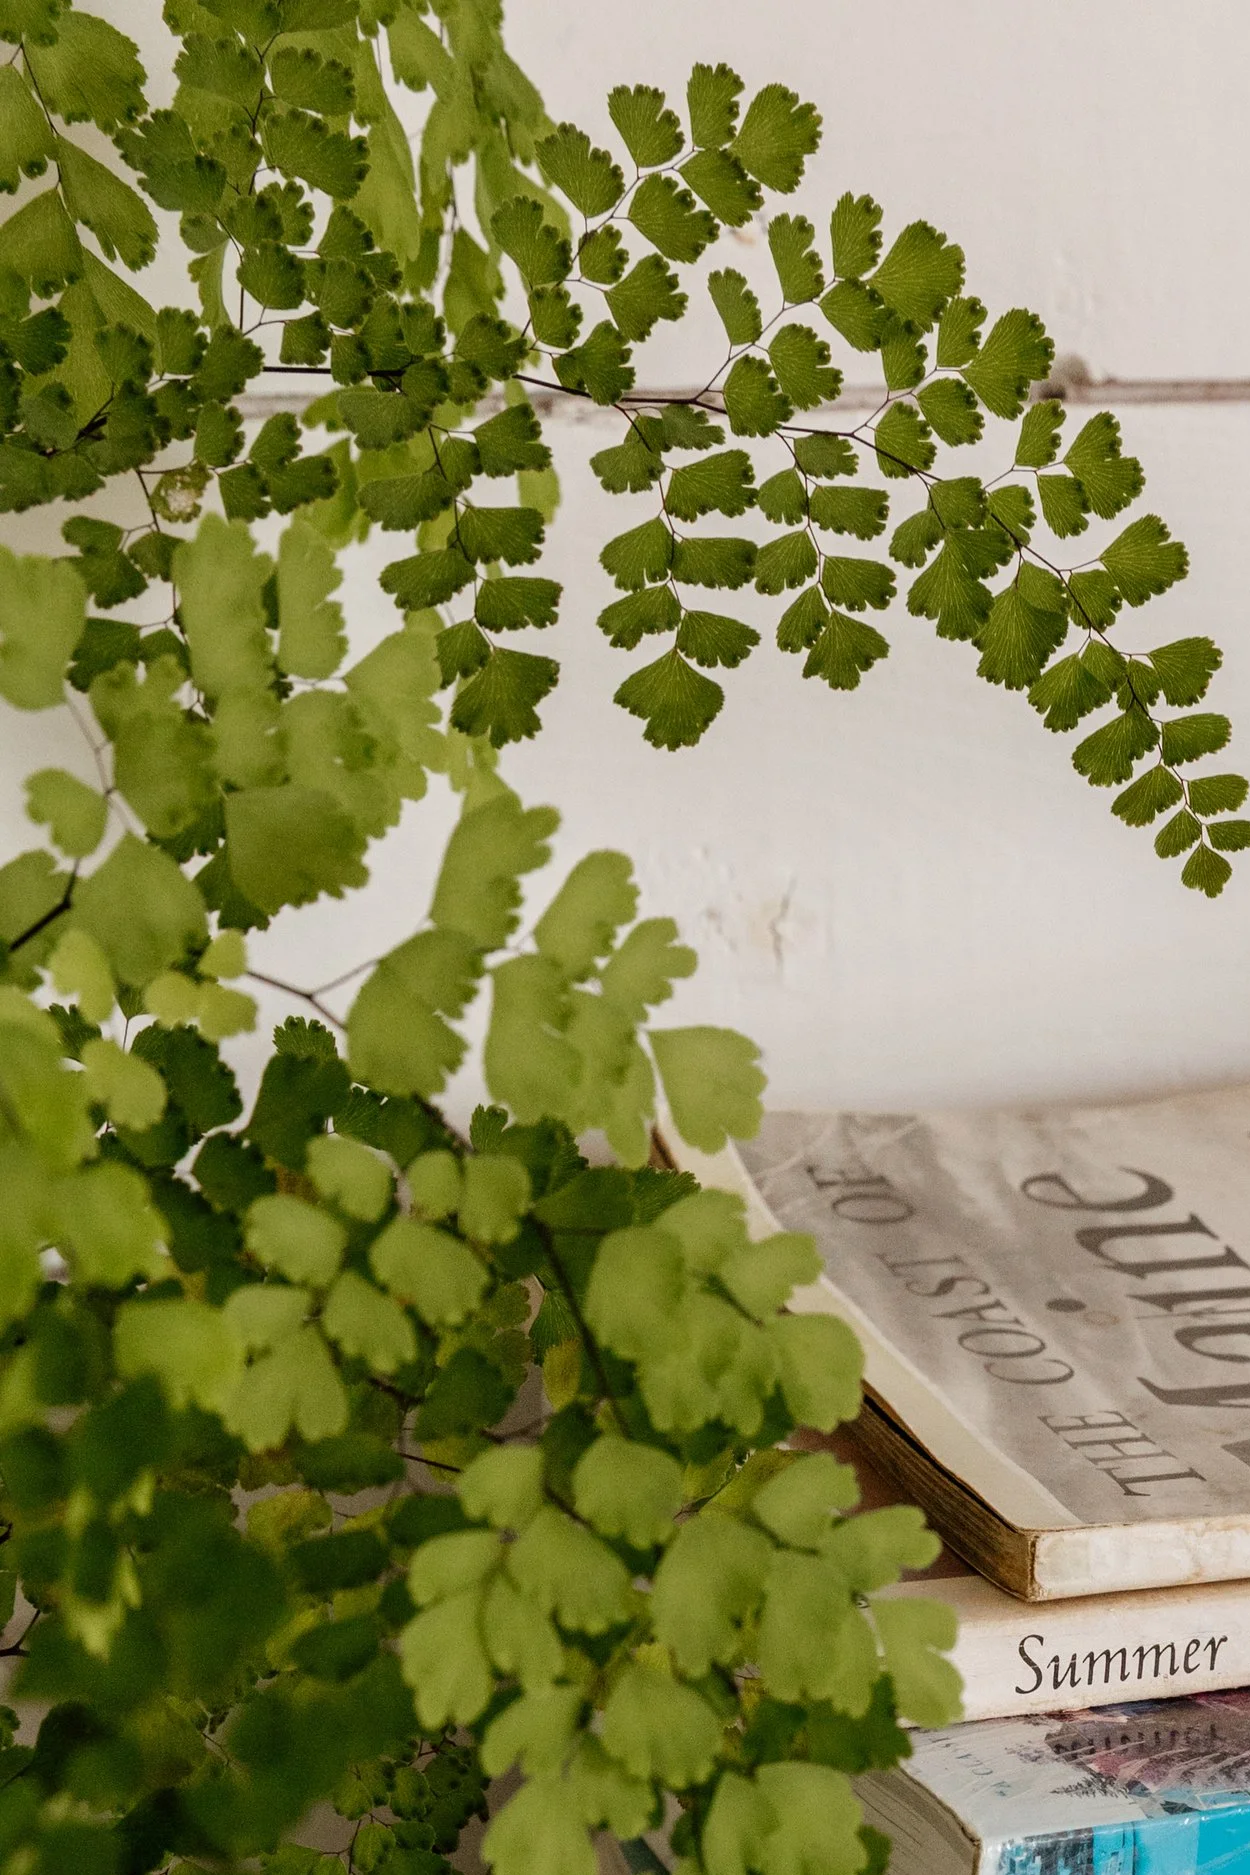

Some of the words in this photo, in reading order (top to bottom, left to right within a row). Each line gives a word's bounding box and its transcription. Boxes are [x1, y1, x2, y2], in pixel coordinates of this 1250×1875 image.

[806, 1164, 916, 1225] OF
[876, 1252, 1075, 1386] COAST
[1037, 1410, 1208, 1497] THE
[1015, 1632, 1228, 1695] Summer
